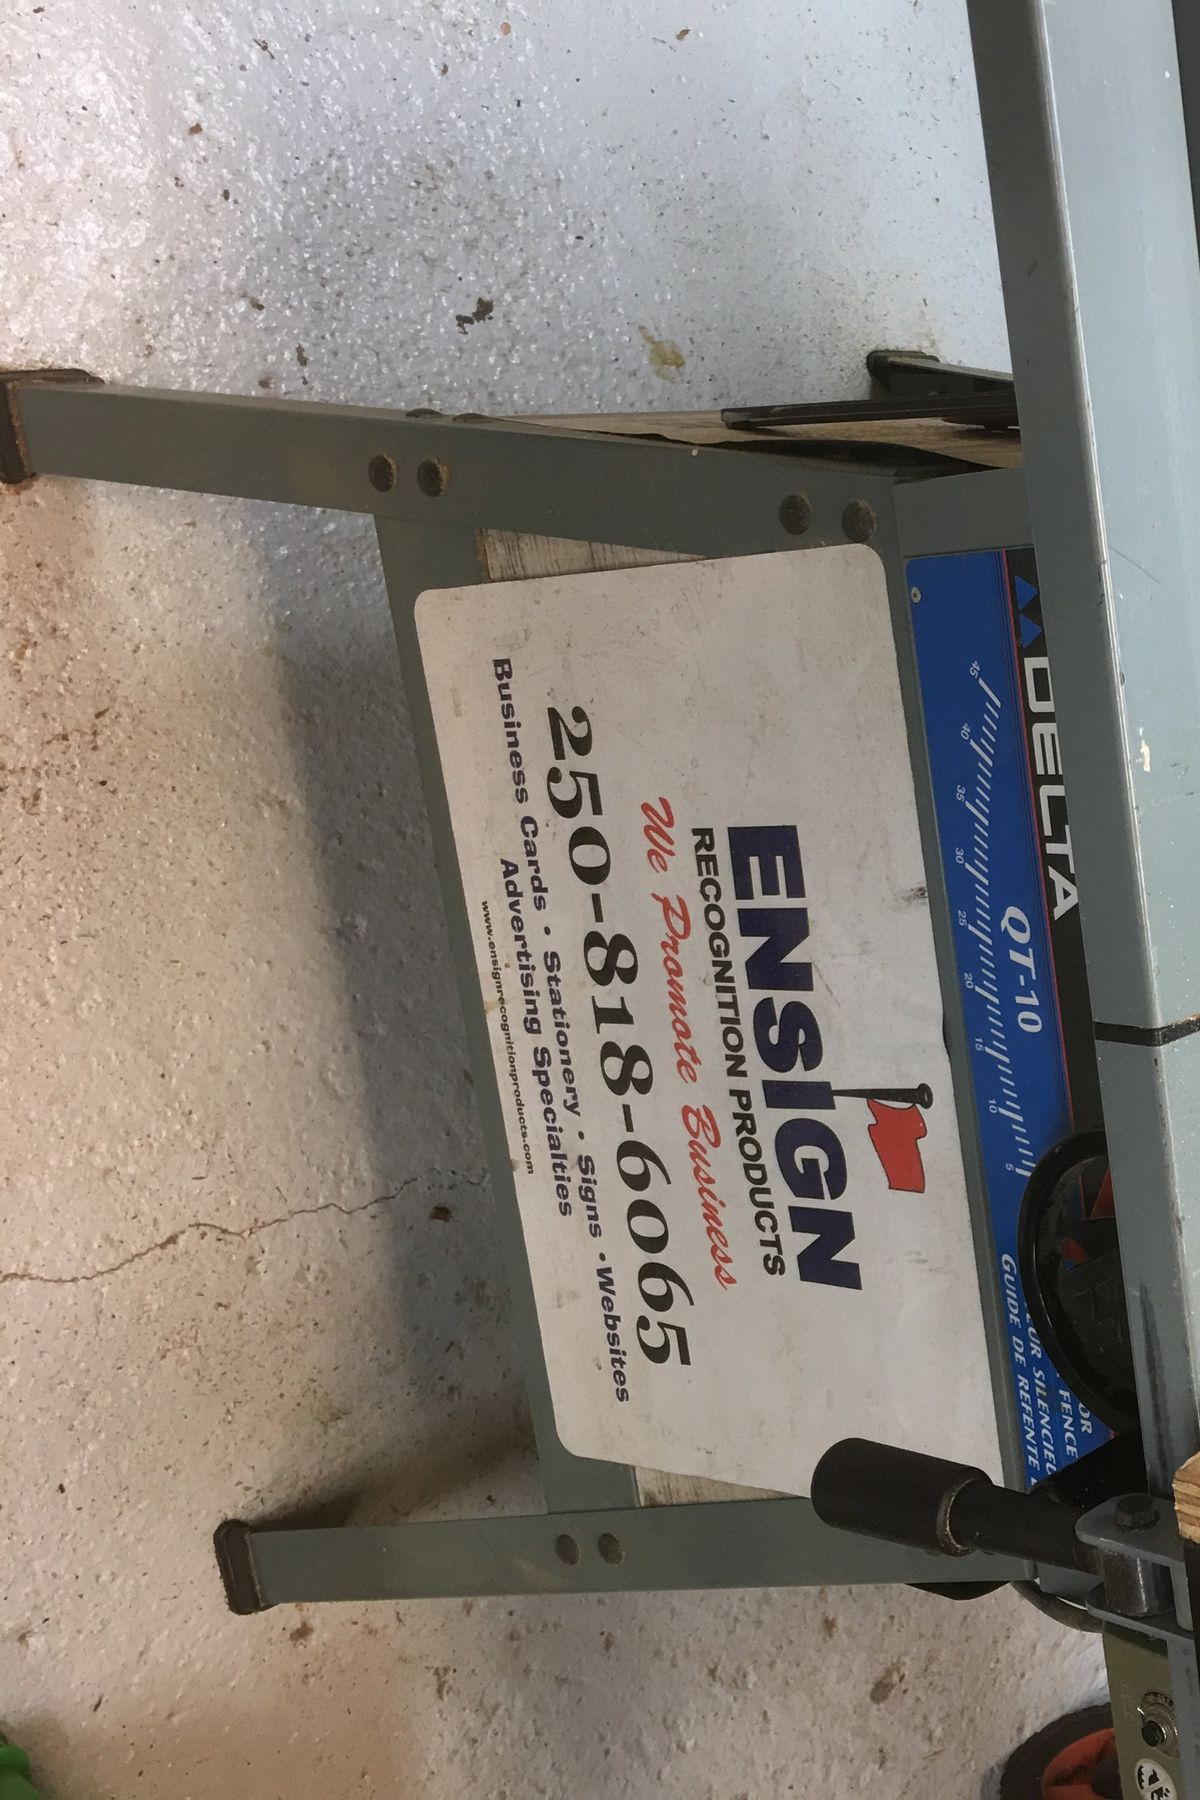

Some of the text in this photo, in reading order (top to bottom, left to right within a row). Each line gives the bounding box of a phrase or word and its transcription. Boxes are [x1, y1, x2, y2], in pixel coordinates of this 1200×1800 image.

[954, 660, 1015, 1172] 45 40 35 30 25 20 15 10 5
[1023, 656, 1079, 922] DELTA
[481, 900, 536, 1175] www.ensignrecognitionproducts.com
[492, 658, 632, 1403] Business Cards Stationery Signs Websites
[500, 858, 574, 1217] Advertising Specialties
[546, 705, 695, 1367] 250-818-6065
[640, 796, 739, 1291] We Promote Business
[692, 827, 787, 1277] RECOGNITION PRODUCTS
[727, 825, 863, 1291] ENSIGN
[1001, 906, 1043, 1033] QT-10
[1001, 1253, 1022, 1329] GUIDE
[1012, 1335, 1027, 1368] DE
[1017, 1374, 1040, 1472] REFENTE
[1058, 1390, 1079, 1458] FENCE
